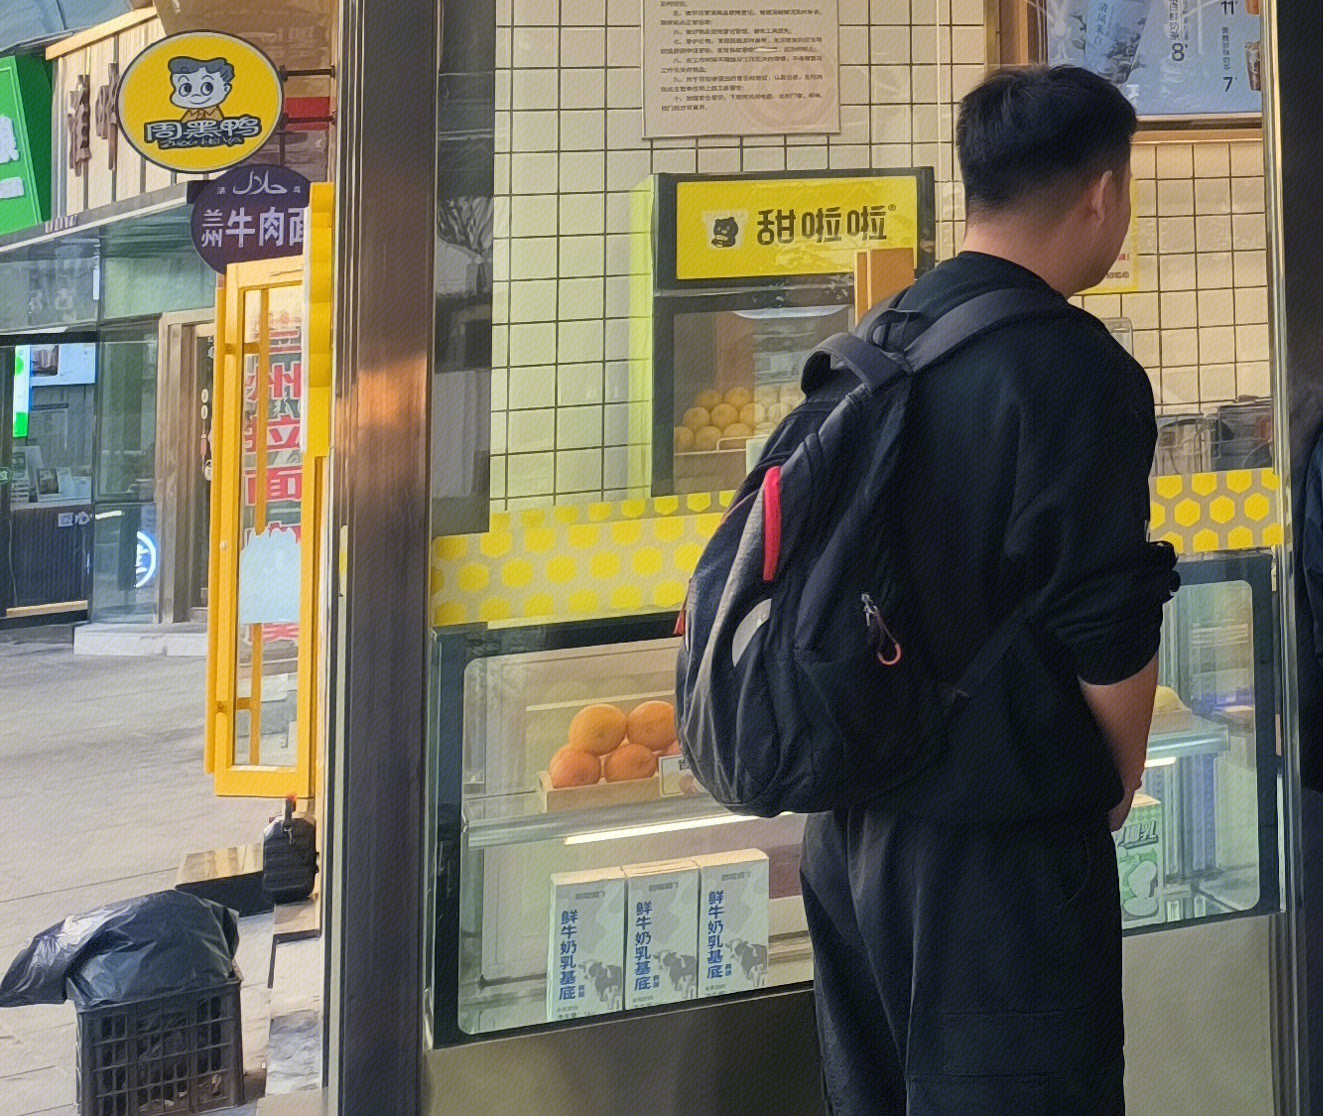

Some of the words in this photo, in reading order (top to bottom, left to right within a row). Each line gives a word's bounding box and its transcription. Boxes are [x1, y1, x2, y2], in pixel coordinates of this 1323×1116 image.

[146, 115, 262, 142] 周黑鸭
[233, 169, 288, 195] حلال
[202, 208, 224, 248] 兰州
[756, 204, 888, 246] 甜啦啦
[558, 908, 579, 1001] 鲜牛奶乳基底
[633, 900, 653, 992] 鲜牛奶乳基底
[706, 889, 725, 980] 鲜牛奶乳基底
